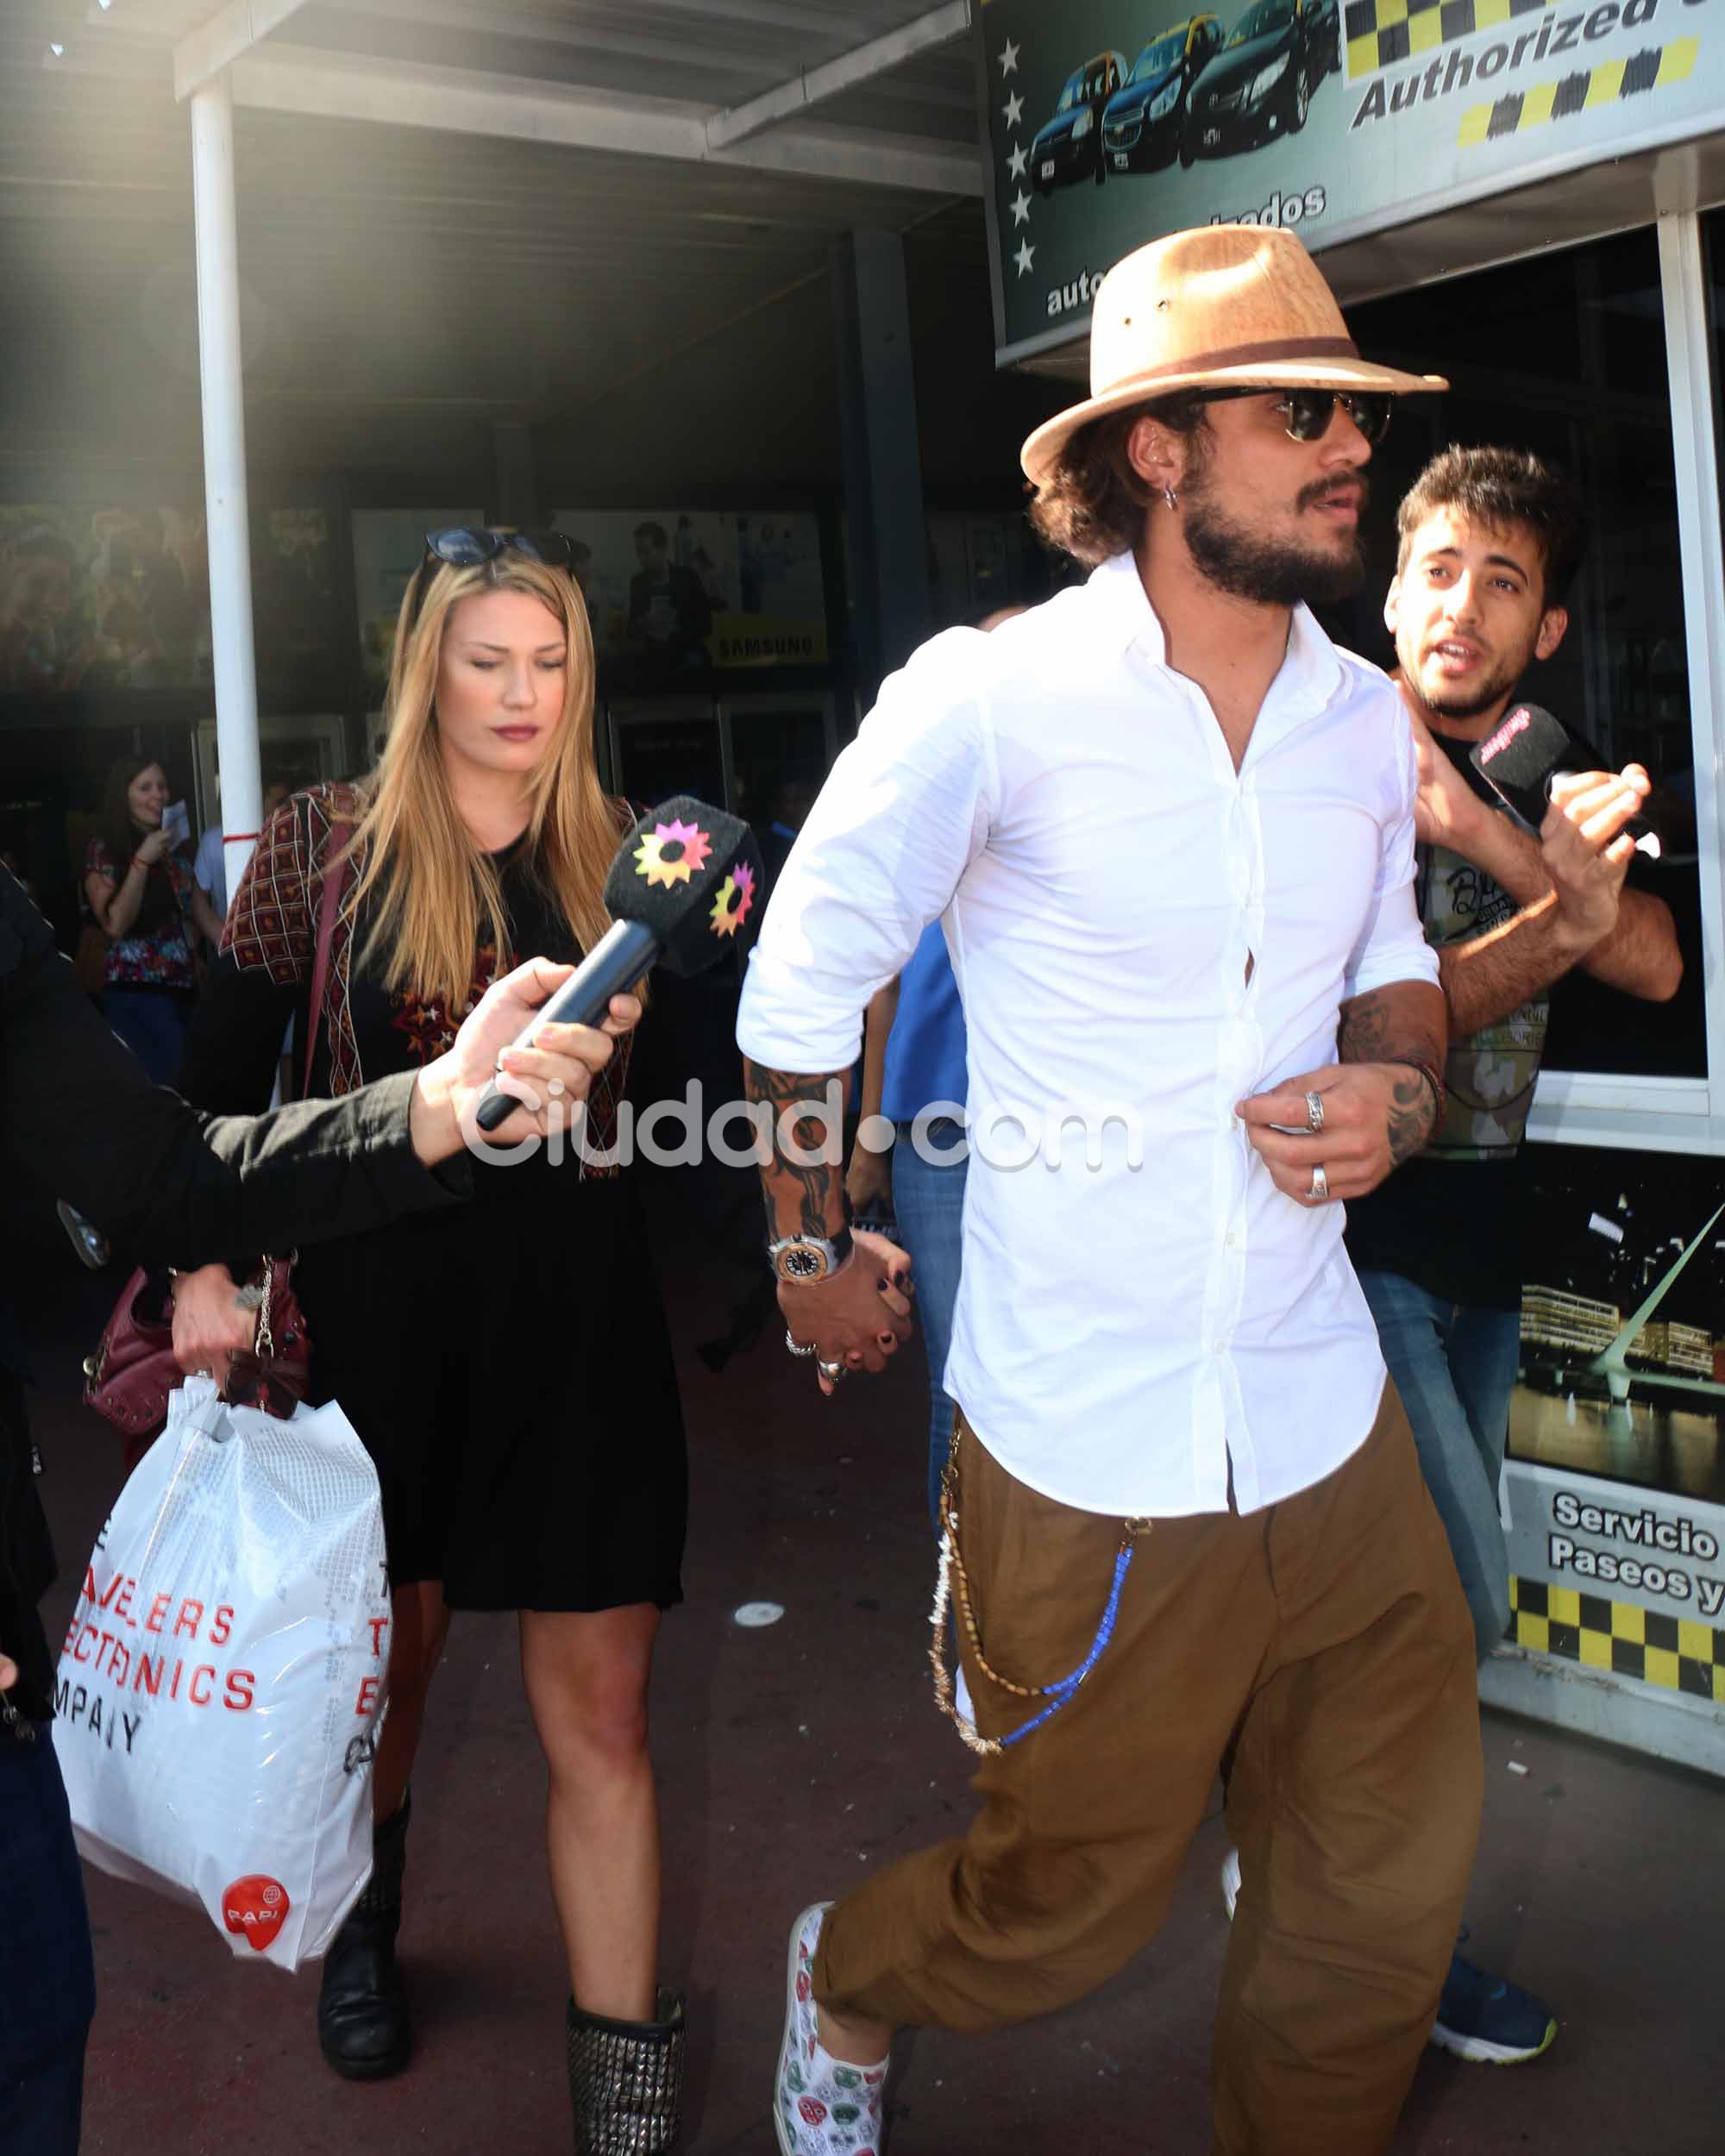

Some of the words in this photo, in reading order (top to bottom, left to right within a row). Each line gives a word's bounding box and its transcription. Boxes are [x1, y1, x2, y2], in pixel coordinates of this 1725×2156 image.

[1351, 0, 1658, 130] Authorized
[718, 636, 812, 658] SAMSUNG
[1553, 1493, 1718, 1561] Servicio
[1548, 1532, 1691, 1601] Paseos
[1696, 1573, 1725, 1616] y
